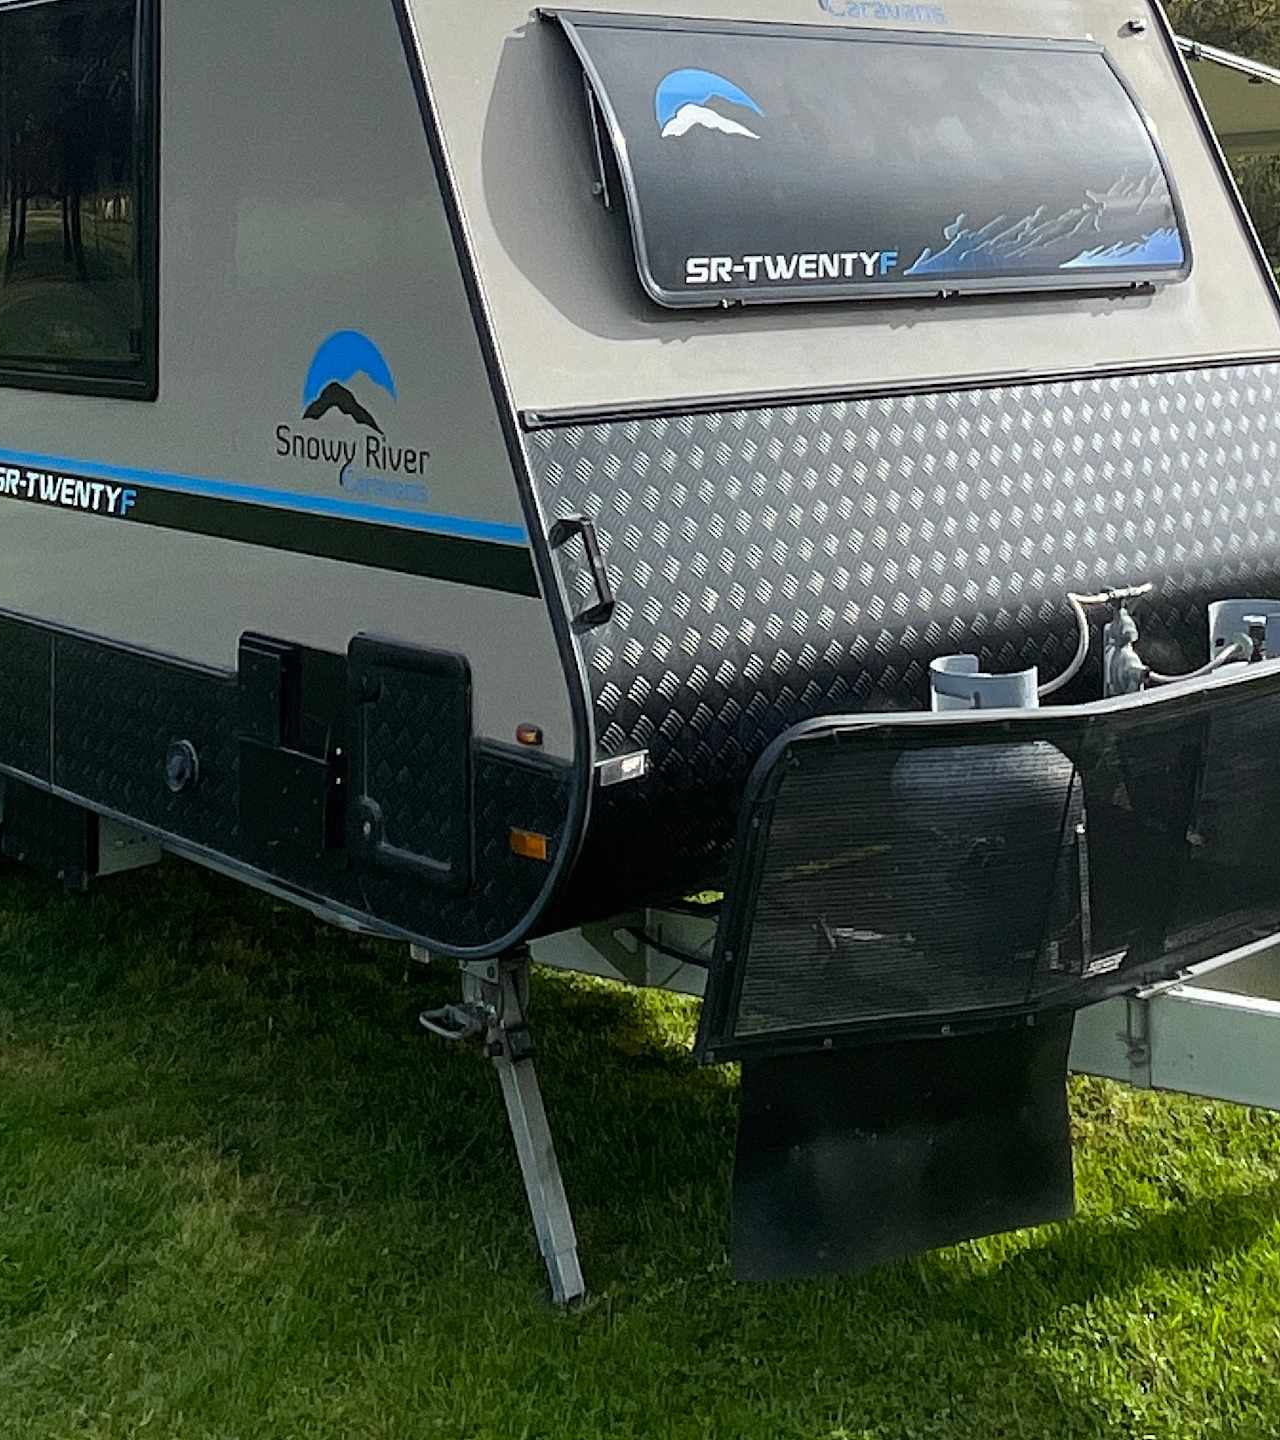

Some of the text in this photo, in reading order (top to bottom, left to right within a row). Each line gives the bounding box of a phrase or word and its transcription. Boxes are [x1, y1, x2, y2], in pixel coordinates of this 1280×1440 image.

[685, 251, 898, 284] SR-TWENTYF
[275, 424, 357, 486] Snowy
[365, 435, 431, 475] River
